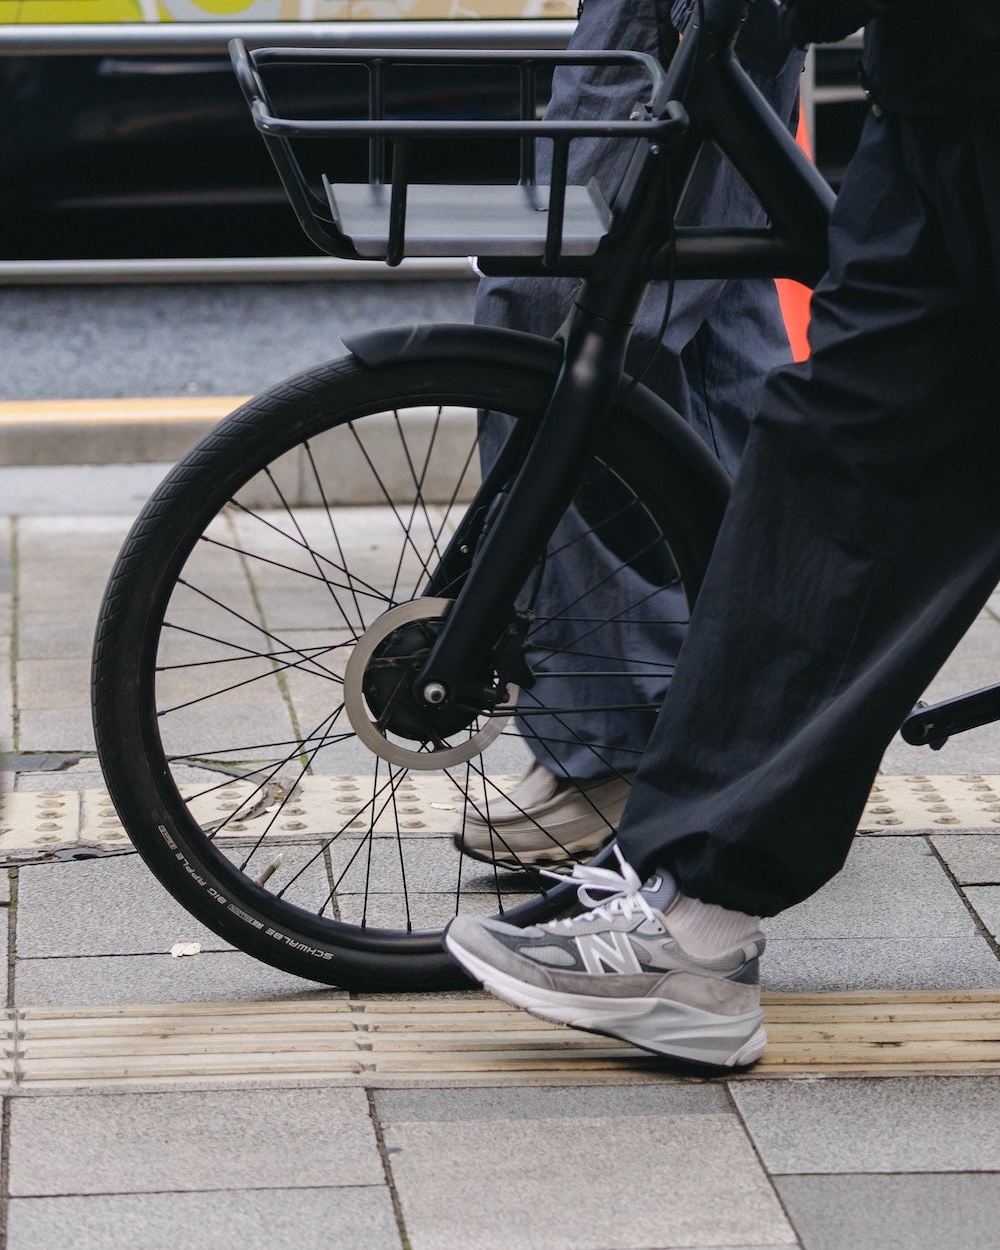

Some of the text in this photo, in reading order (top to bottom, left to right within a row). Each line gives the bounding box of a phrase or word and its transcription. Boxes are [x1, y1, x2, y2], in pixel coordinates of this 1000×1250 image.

[175, 852, 334, 961] SCHWALBE BIG APPLE
[573, 930, 643, 974] N
